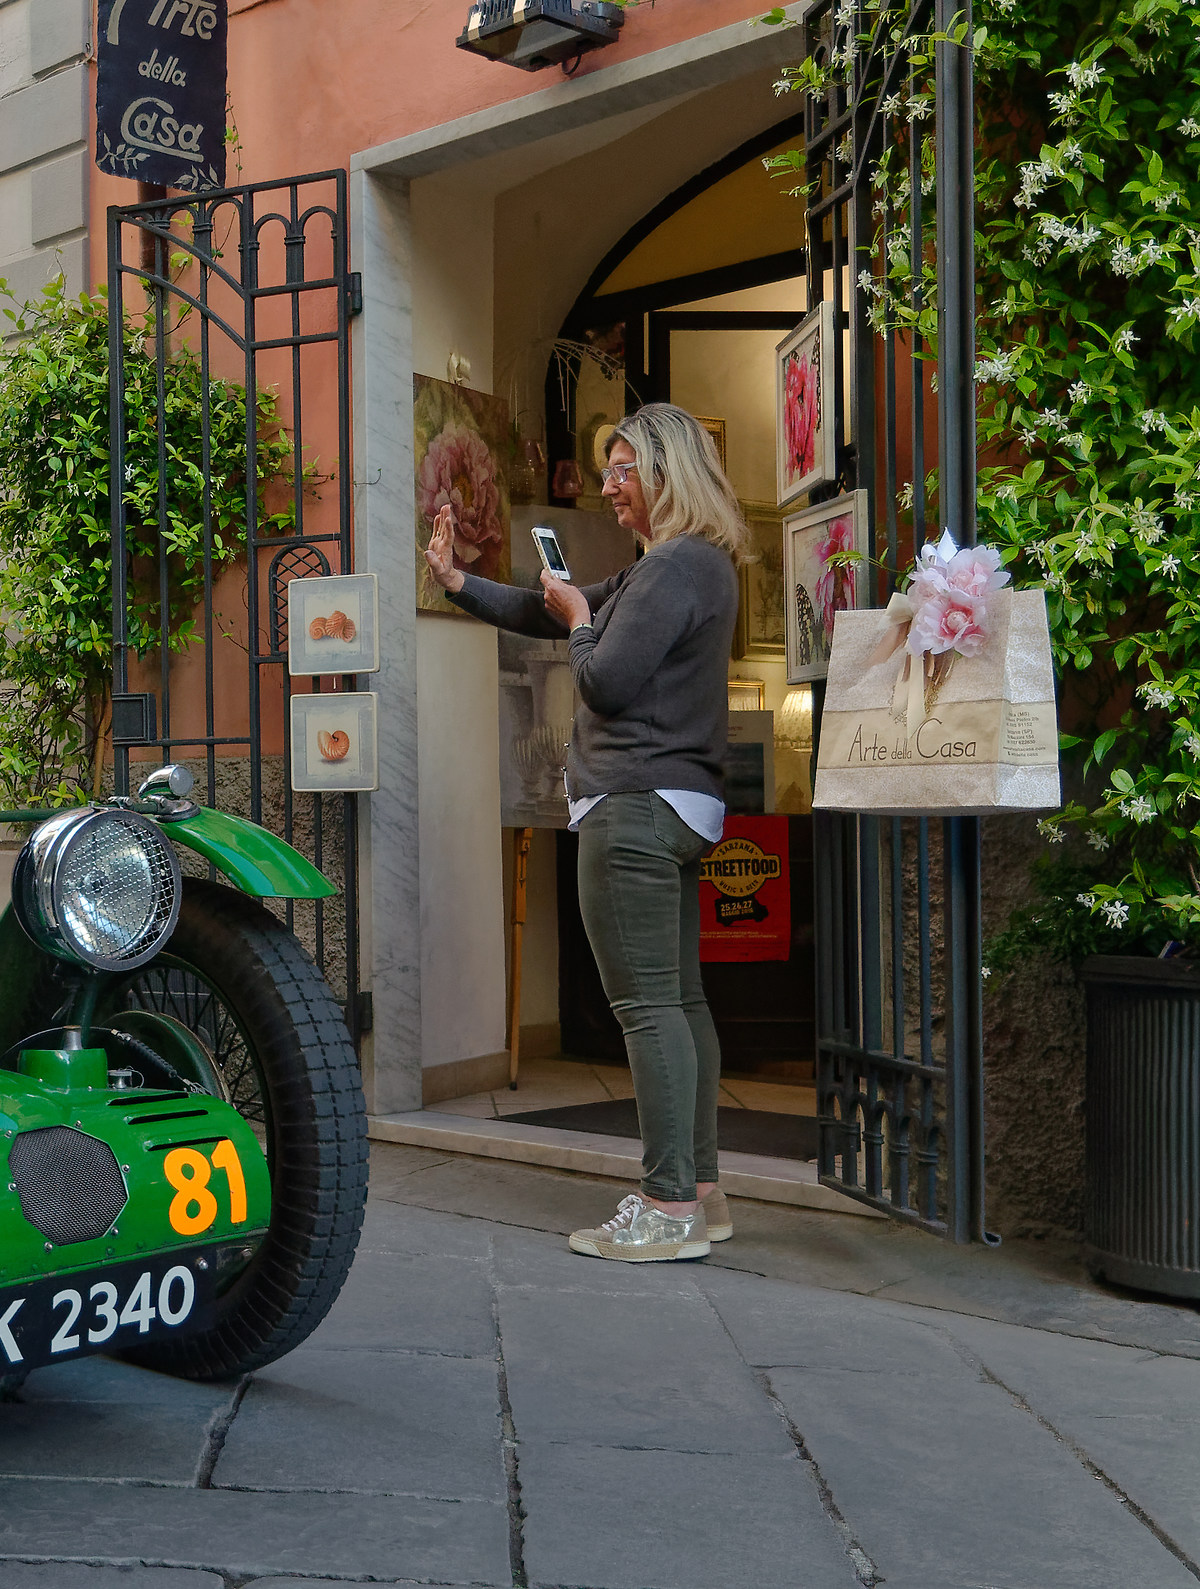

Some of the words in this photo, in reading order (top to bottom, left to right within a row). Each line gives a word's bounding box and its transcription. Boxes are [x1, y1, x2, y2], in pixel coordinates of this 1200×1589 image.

[138, 48, 187, 87] della
[121, 97, 204, 162] Casa
[847, 724, 887, 761] Arte
[890, 738, 912, 760] della
[916, 717, 977, 759] Casa
[700, 859, 778, 877] STREETFOOD
[718, 842, 755, 855] SARZANA
[719, 880, 737, 893] MUSIC
[745, 879, 759, 891] BEER
[163, 1139, 248, 1236] 81
[51, 1265, 195, 1353] 2340
